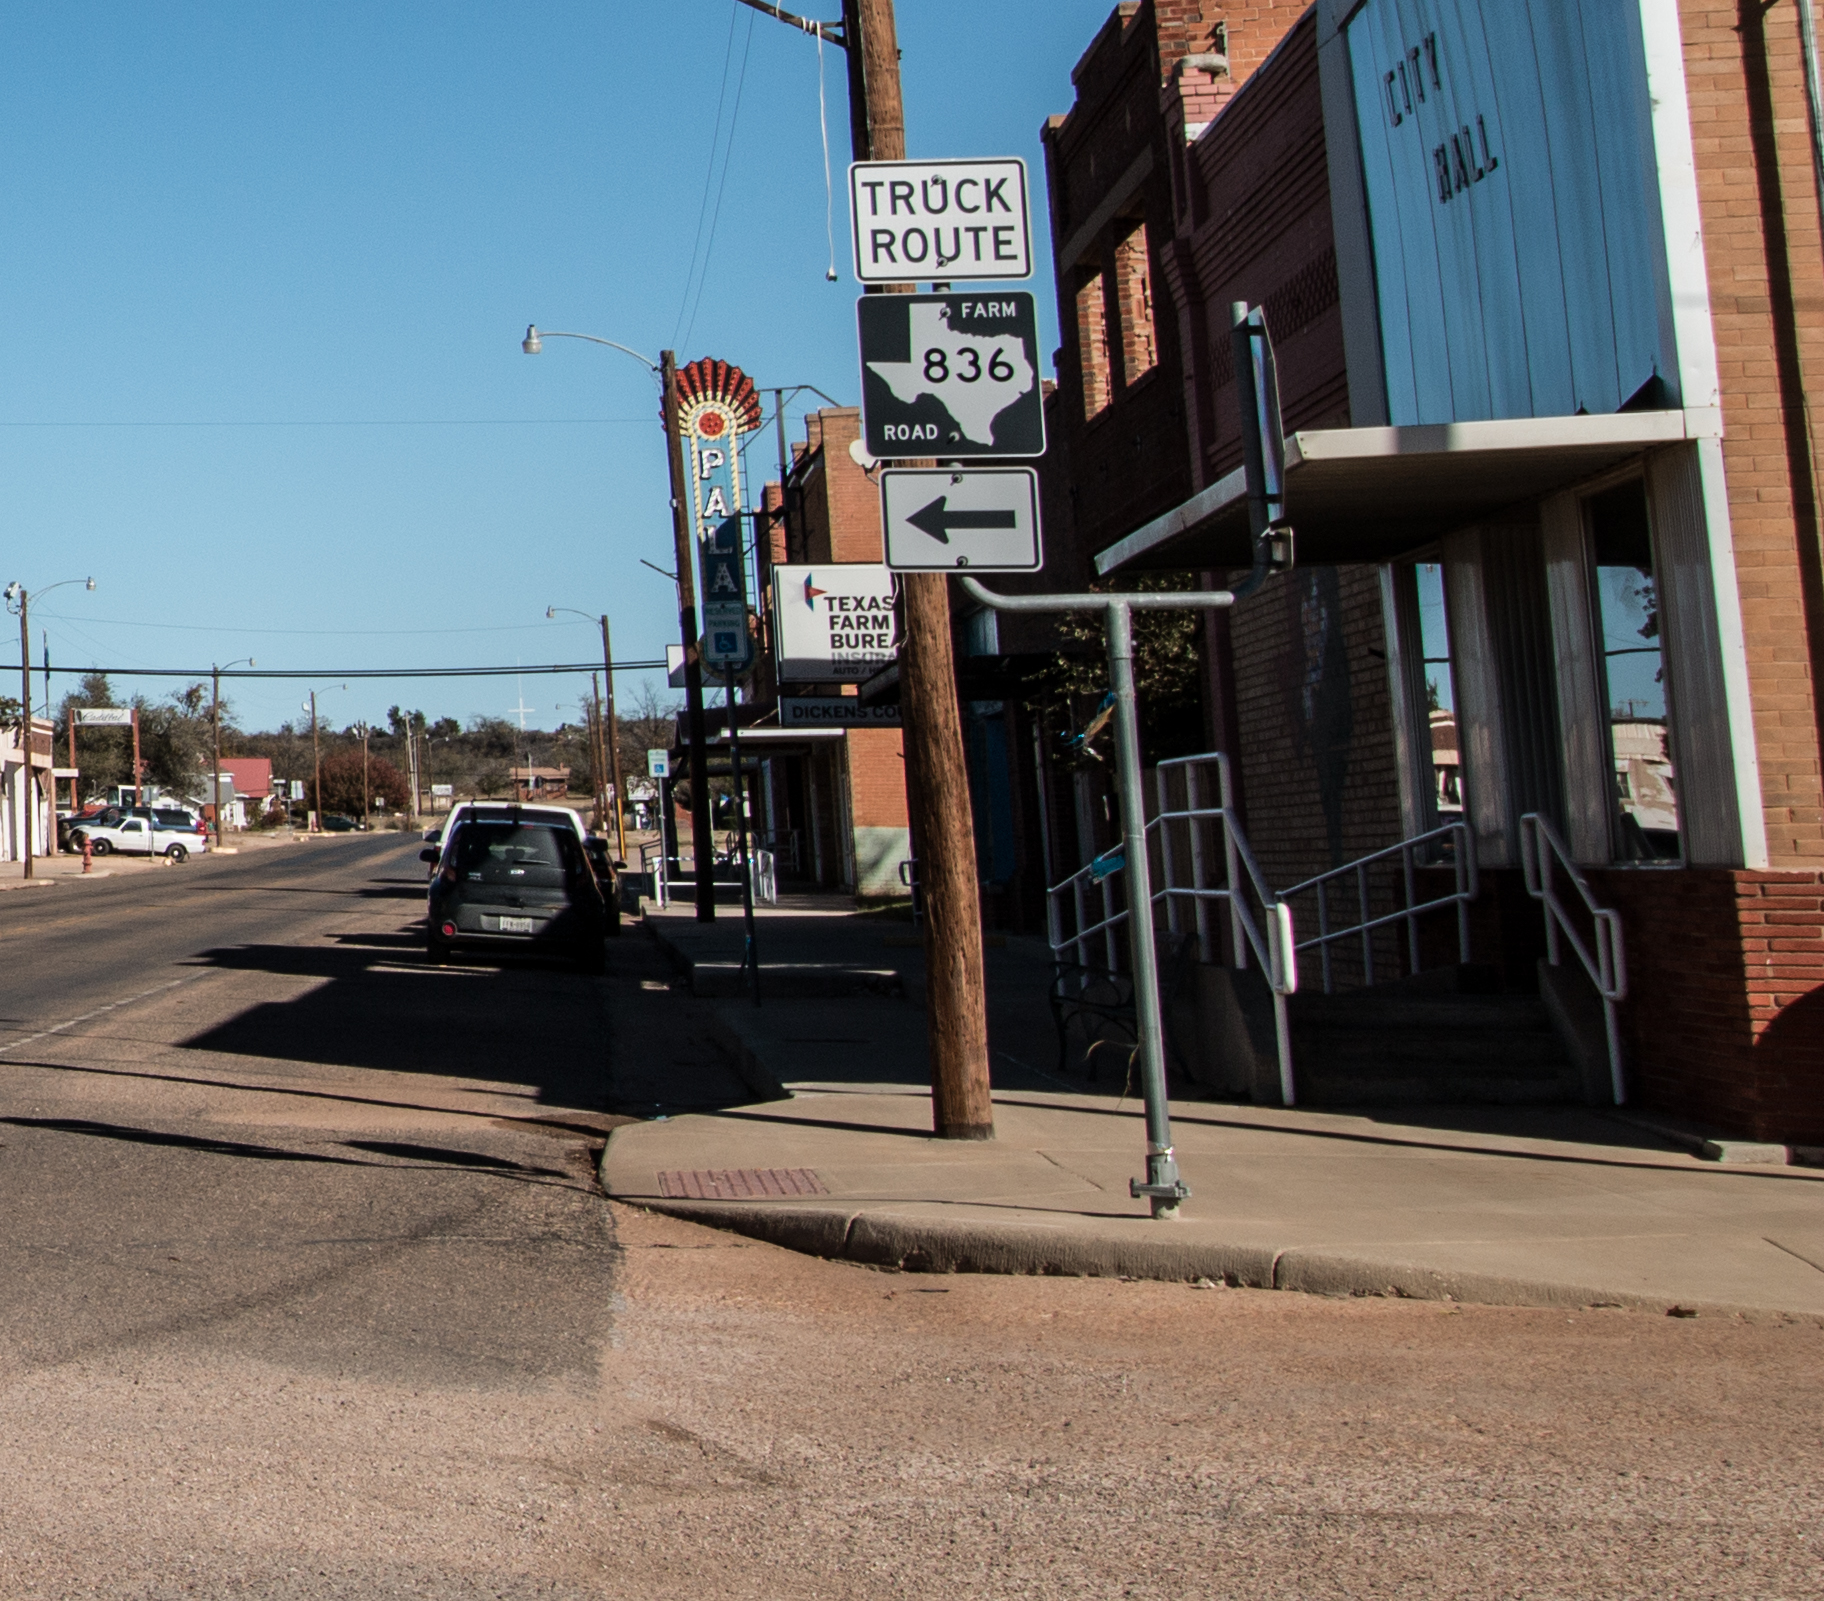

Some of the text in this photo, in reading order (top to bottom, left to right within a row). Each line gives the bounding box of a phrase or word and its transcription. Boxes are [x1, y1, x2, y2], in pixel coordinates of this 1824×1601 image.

[1383, 31, 1441, 128] CITY
[1432, 113, 1499, 204] HALL
[861, 177, 1013, 217] TRUCK
[869, 225, 1019, 265] ROUTE
[960, 302, 1017, 319] FARM
[922, 347, 1015, 384] 836
[883, 424, 939, 441] ROAD
[699, 448, 741, 668] PALA
[824, 596, 895, 612] TEXAS
[708, 619, 741, 627] PARKING
[829, 615, 890, 631] FARM
[830, 633, 893, 649] BURE
[831, 651, 896, 666] INSURA
[832, 666, 860, 675] AUTO
[792, 705, 868, 719] DICKENS
